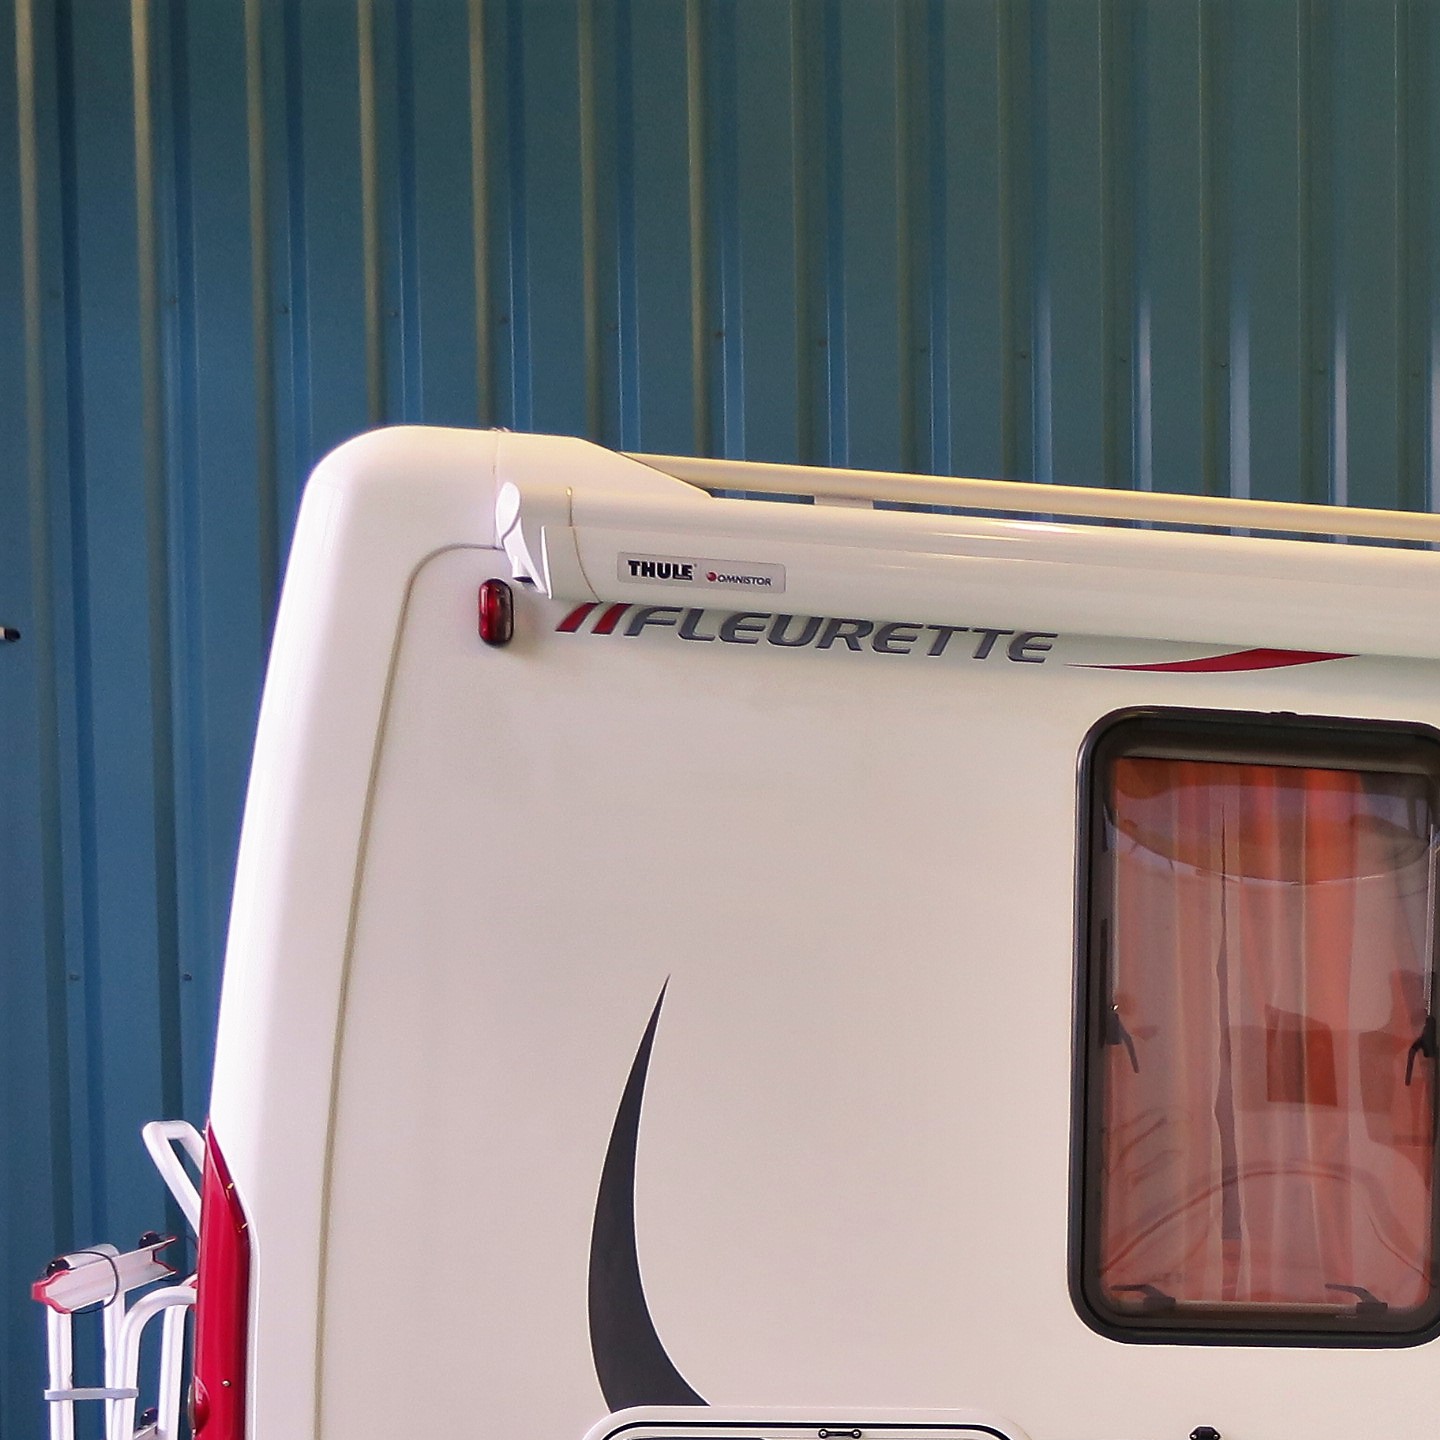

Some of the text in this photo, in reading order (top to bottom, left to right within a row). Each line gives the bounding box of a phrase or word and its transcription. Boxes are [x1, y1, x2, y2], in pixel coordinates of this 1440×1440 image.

[627, 559, 693, 581] THULE
[717, 573, 772, 587] OMNISTOR
[623, 604, 1059, 664] FLEURETTE
